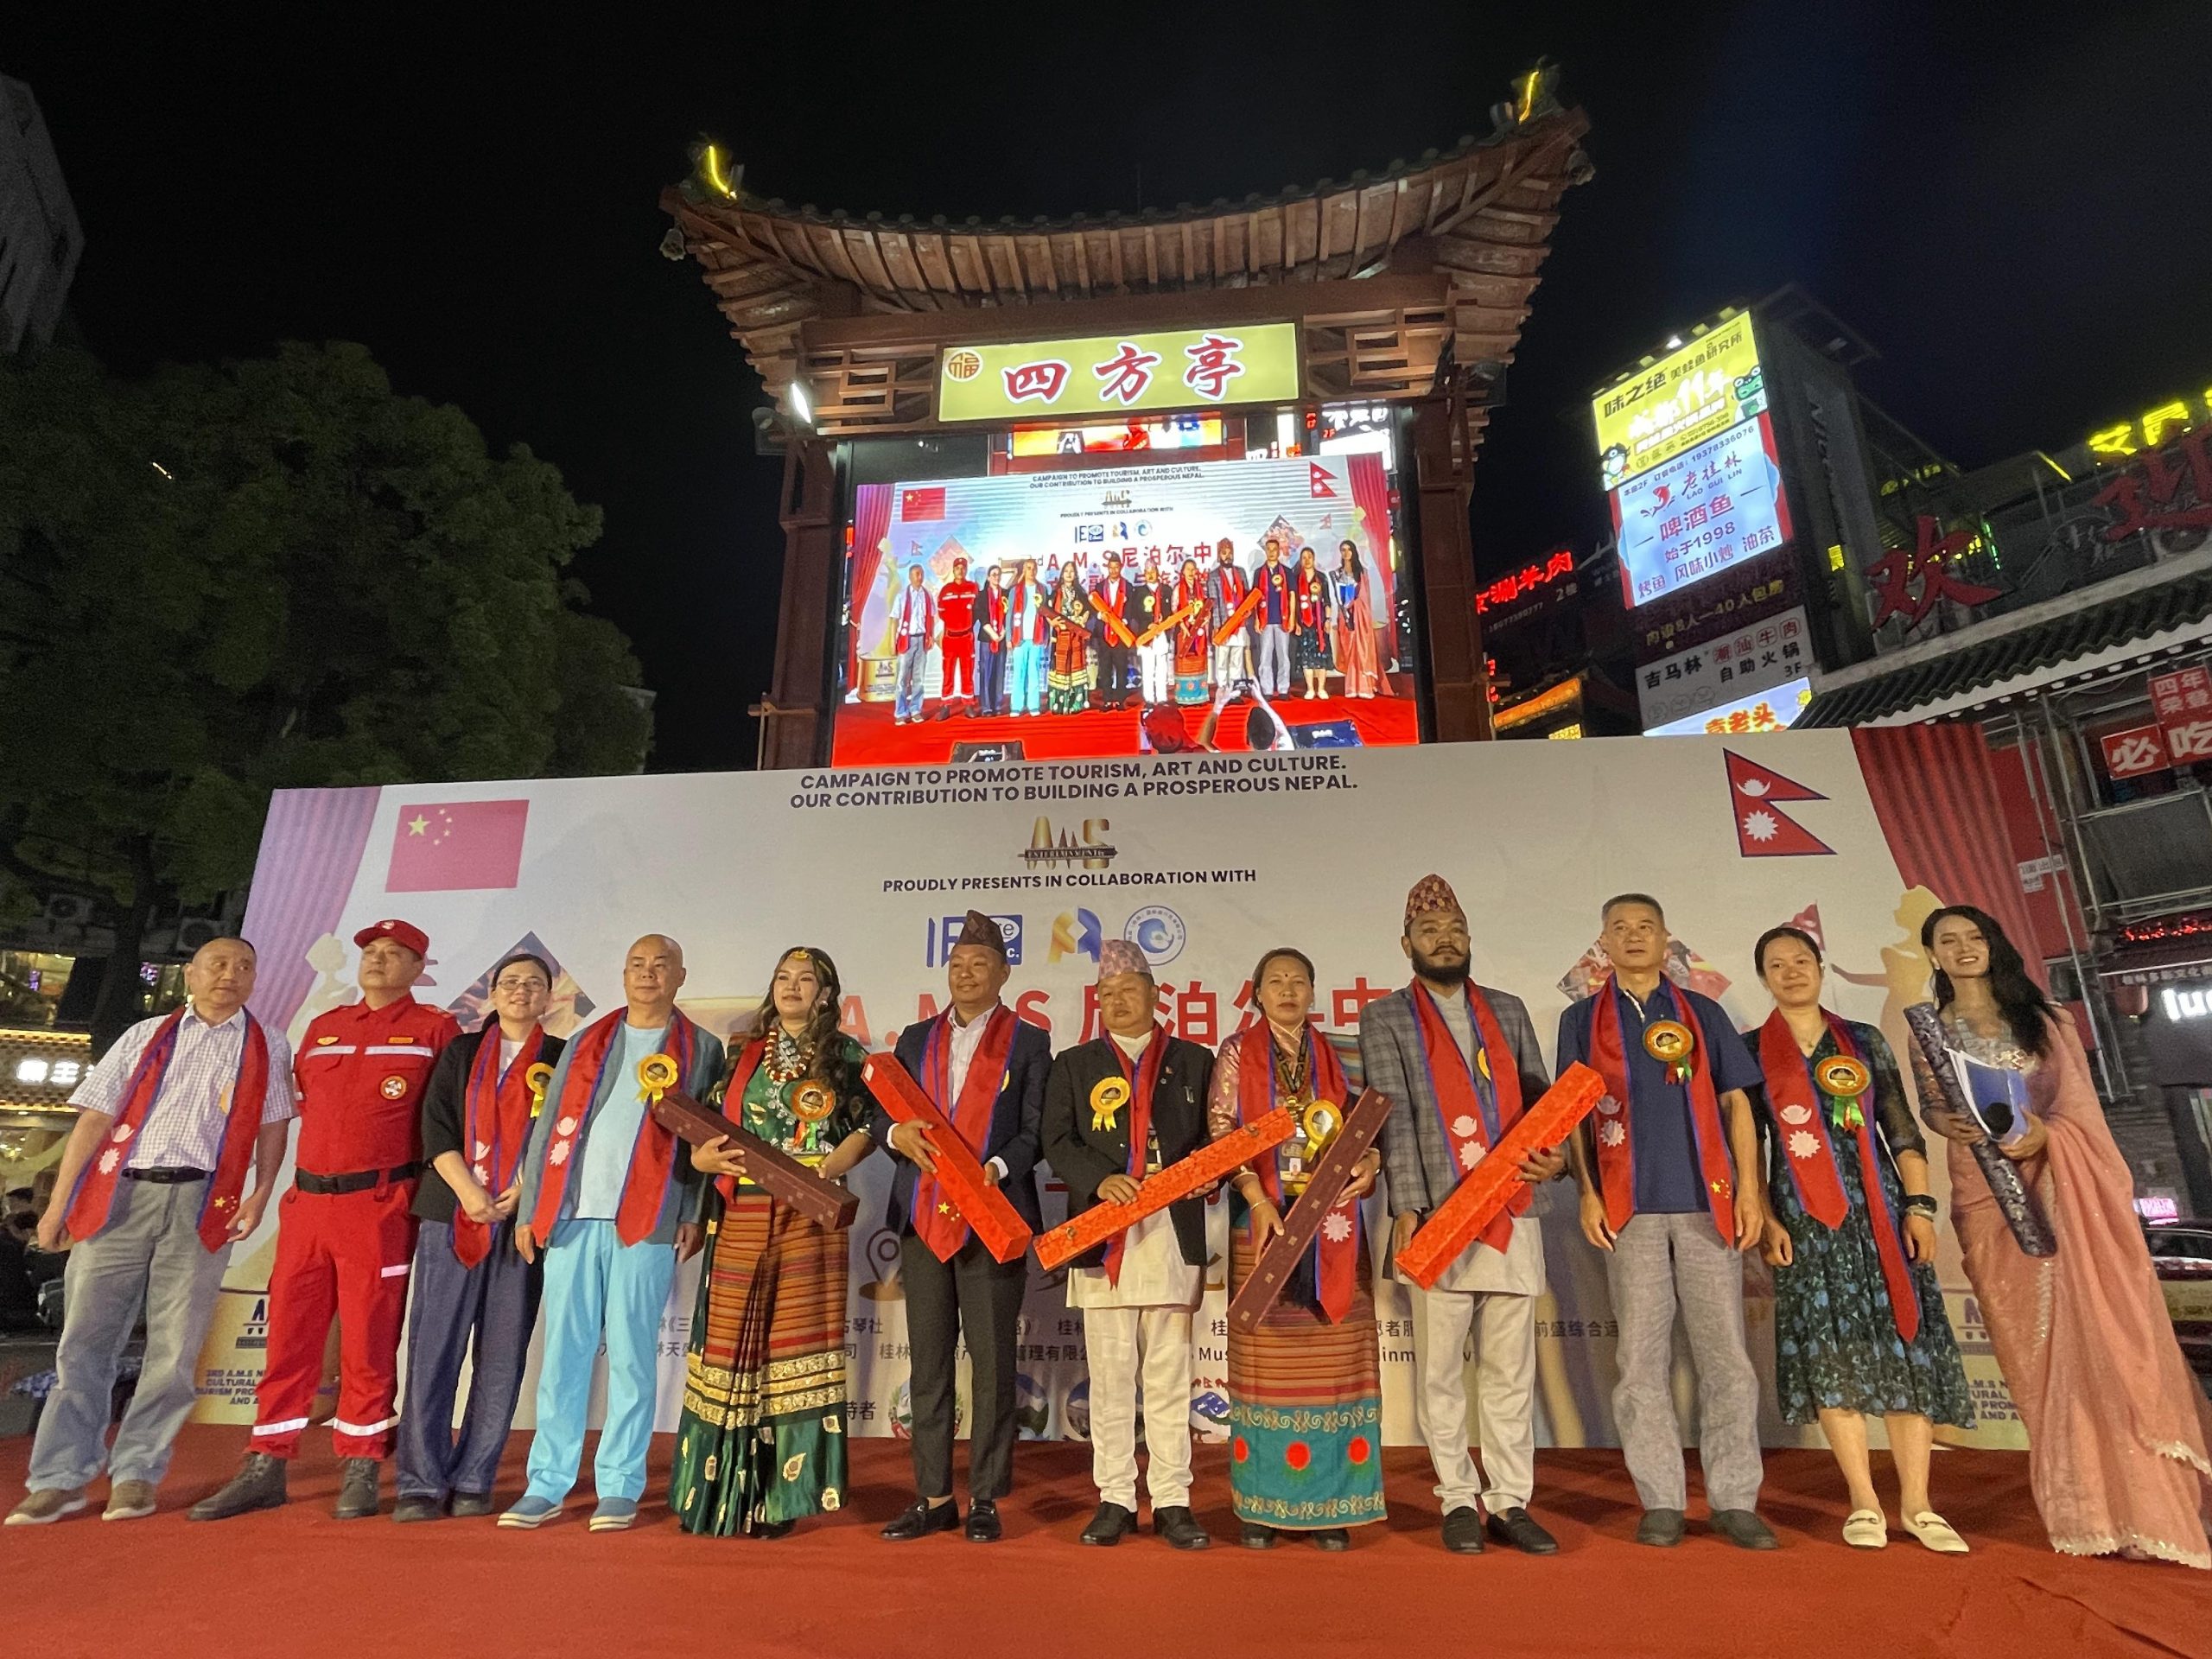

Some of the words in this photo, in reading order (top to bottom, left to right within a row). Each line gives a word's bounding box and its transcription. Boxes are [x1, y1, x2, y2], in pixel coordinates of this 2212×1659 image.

[948, 351, 981, 379] 福
[1004, 337, 1243, 402] 四方亭
[1604, 366, 1669, 418] 味之绝
[1691, 425, 1754, 462] 19378336076
[1681, 450, 1742, 497] 老桂林
[1687, 487, 1703, 499] LAO
[1708, 478, 1724, 490] GUI
[1728, 468, 1743, 480] LIN
[1659, 493, 1735, 542] 啤酒鱼
[1638, 575, 1666, 599] 烤鱼
[1675, 544, 1734, 582] 风味小炒
[1742, 525, 1775, 553] 油茶
[1664, 521, 1736, 563] 始于1998
[1643, 654, 1702, 689] 吉马林
[1713, 618, 1802, 664] 潮汕牛肉
[1719, 642, 1801, 683] 自助火锅
[1783, 662, 1802, 677] 3F
[2112, 721, 2212, 773] 必吃
[790, 793, 831, 809] OUR
[836, 787, 988, 807] CONTRIBUTION
[993, 786, 1020, 801] TO
[1024, 783, 1120, 801] BUILDING
[1123, 782, 1139, 797] A
[1143, 777, 1280, 796] PROSPEROUS
[1285, 774, 1358, 791] NEPAL.
[801, 772, 910, 789] CAMPAIGN
[915, 770, 942, 785] TO
[947, 766, 1044, 784] PROMOTE
[1048, 762, 1147, 780] TOURISM,
[1152, 761, 1192, 777] ART
[1198, 760, 1243, 775] AND
[1247, 755, 1346, 773] CULTURE.
[883, 878, 957, 893] PROUDLY
[962, 875, 1042, 891] PRESENTS
[1045, 874, 1062, 887] IN
[1065, 871, 1208, 887] COLLABORATION
[1211, 869, 1256, 883] WITH
[1199, 1347, 1228, 1362] Mu
